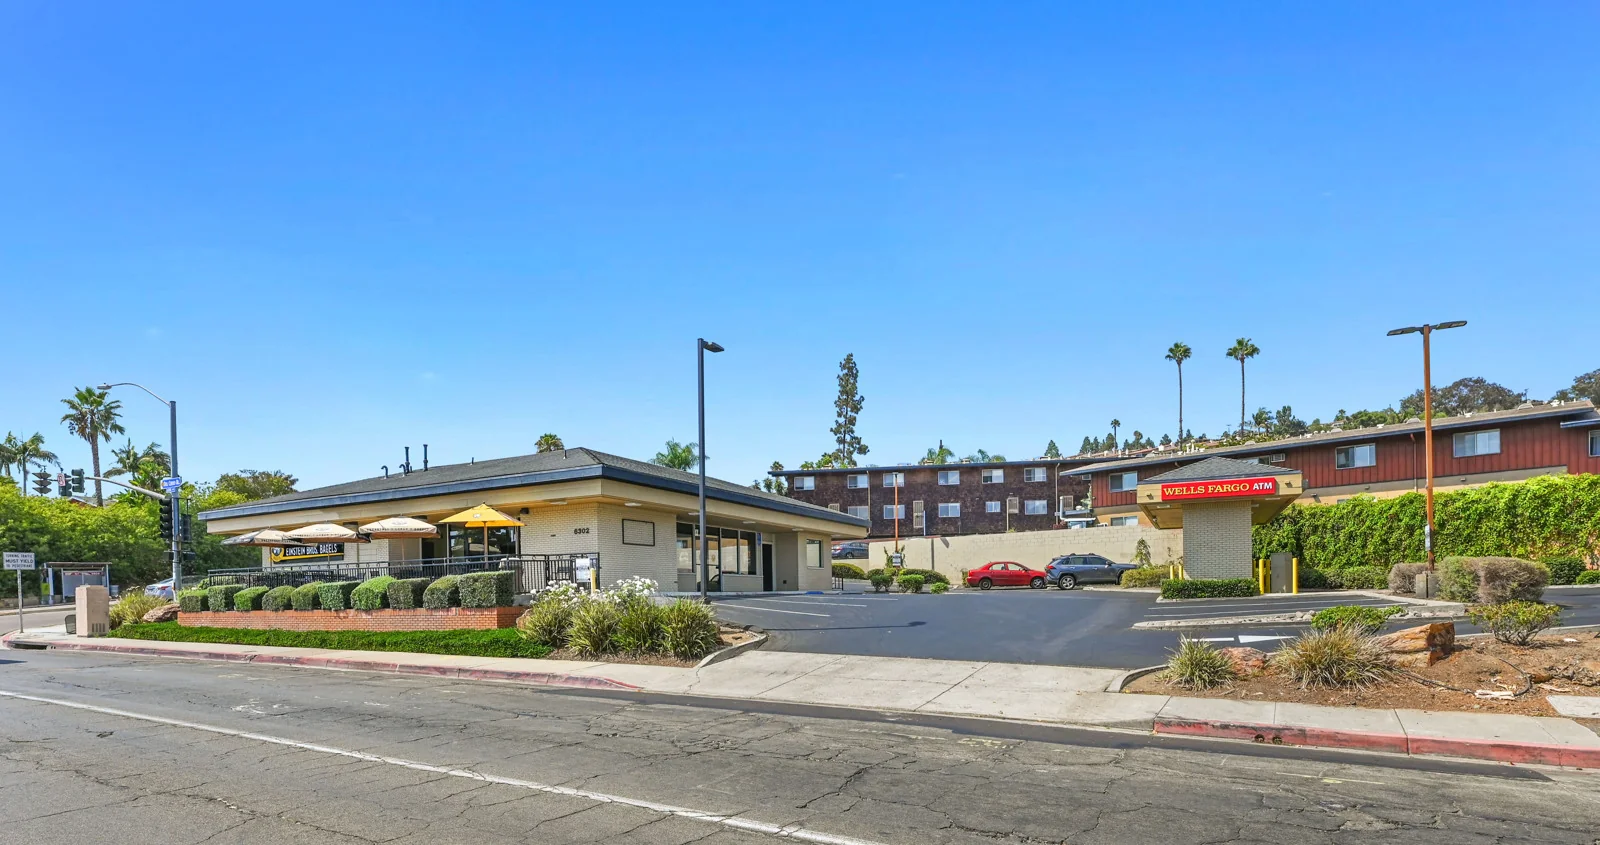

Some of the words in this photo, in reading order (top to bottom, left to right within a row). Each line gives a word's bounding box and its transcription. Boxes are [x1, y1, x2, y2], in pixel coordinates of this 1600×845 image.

[1163, 485, 1205, 496] WELLS
[1207, 483, 1250, 493] FARGO
[1252, 482, 1273, 490] ATM
[286, 547, 306, 556] EINSTEIN
[320, 544, 337, 553] BAGELS
